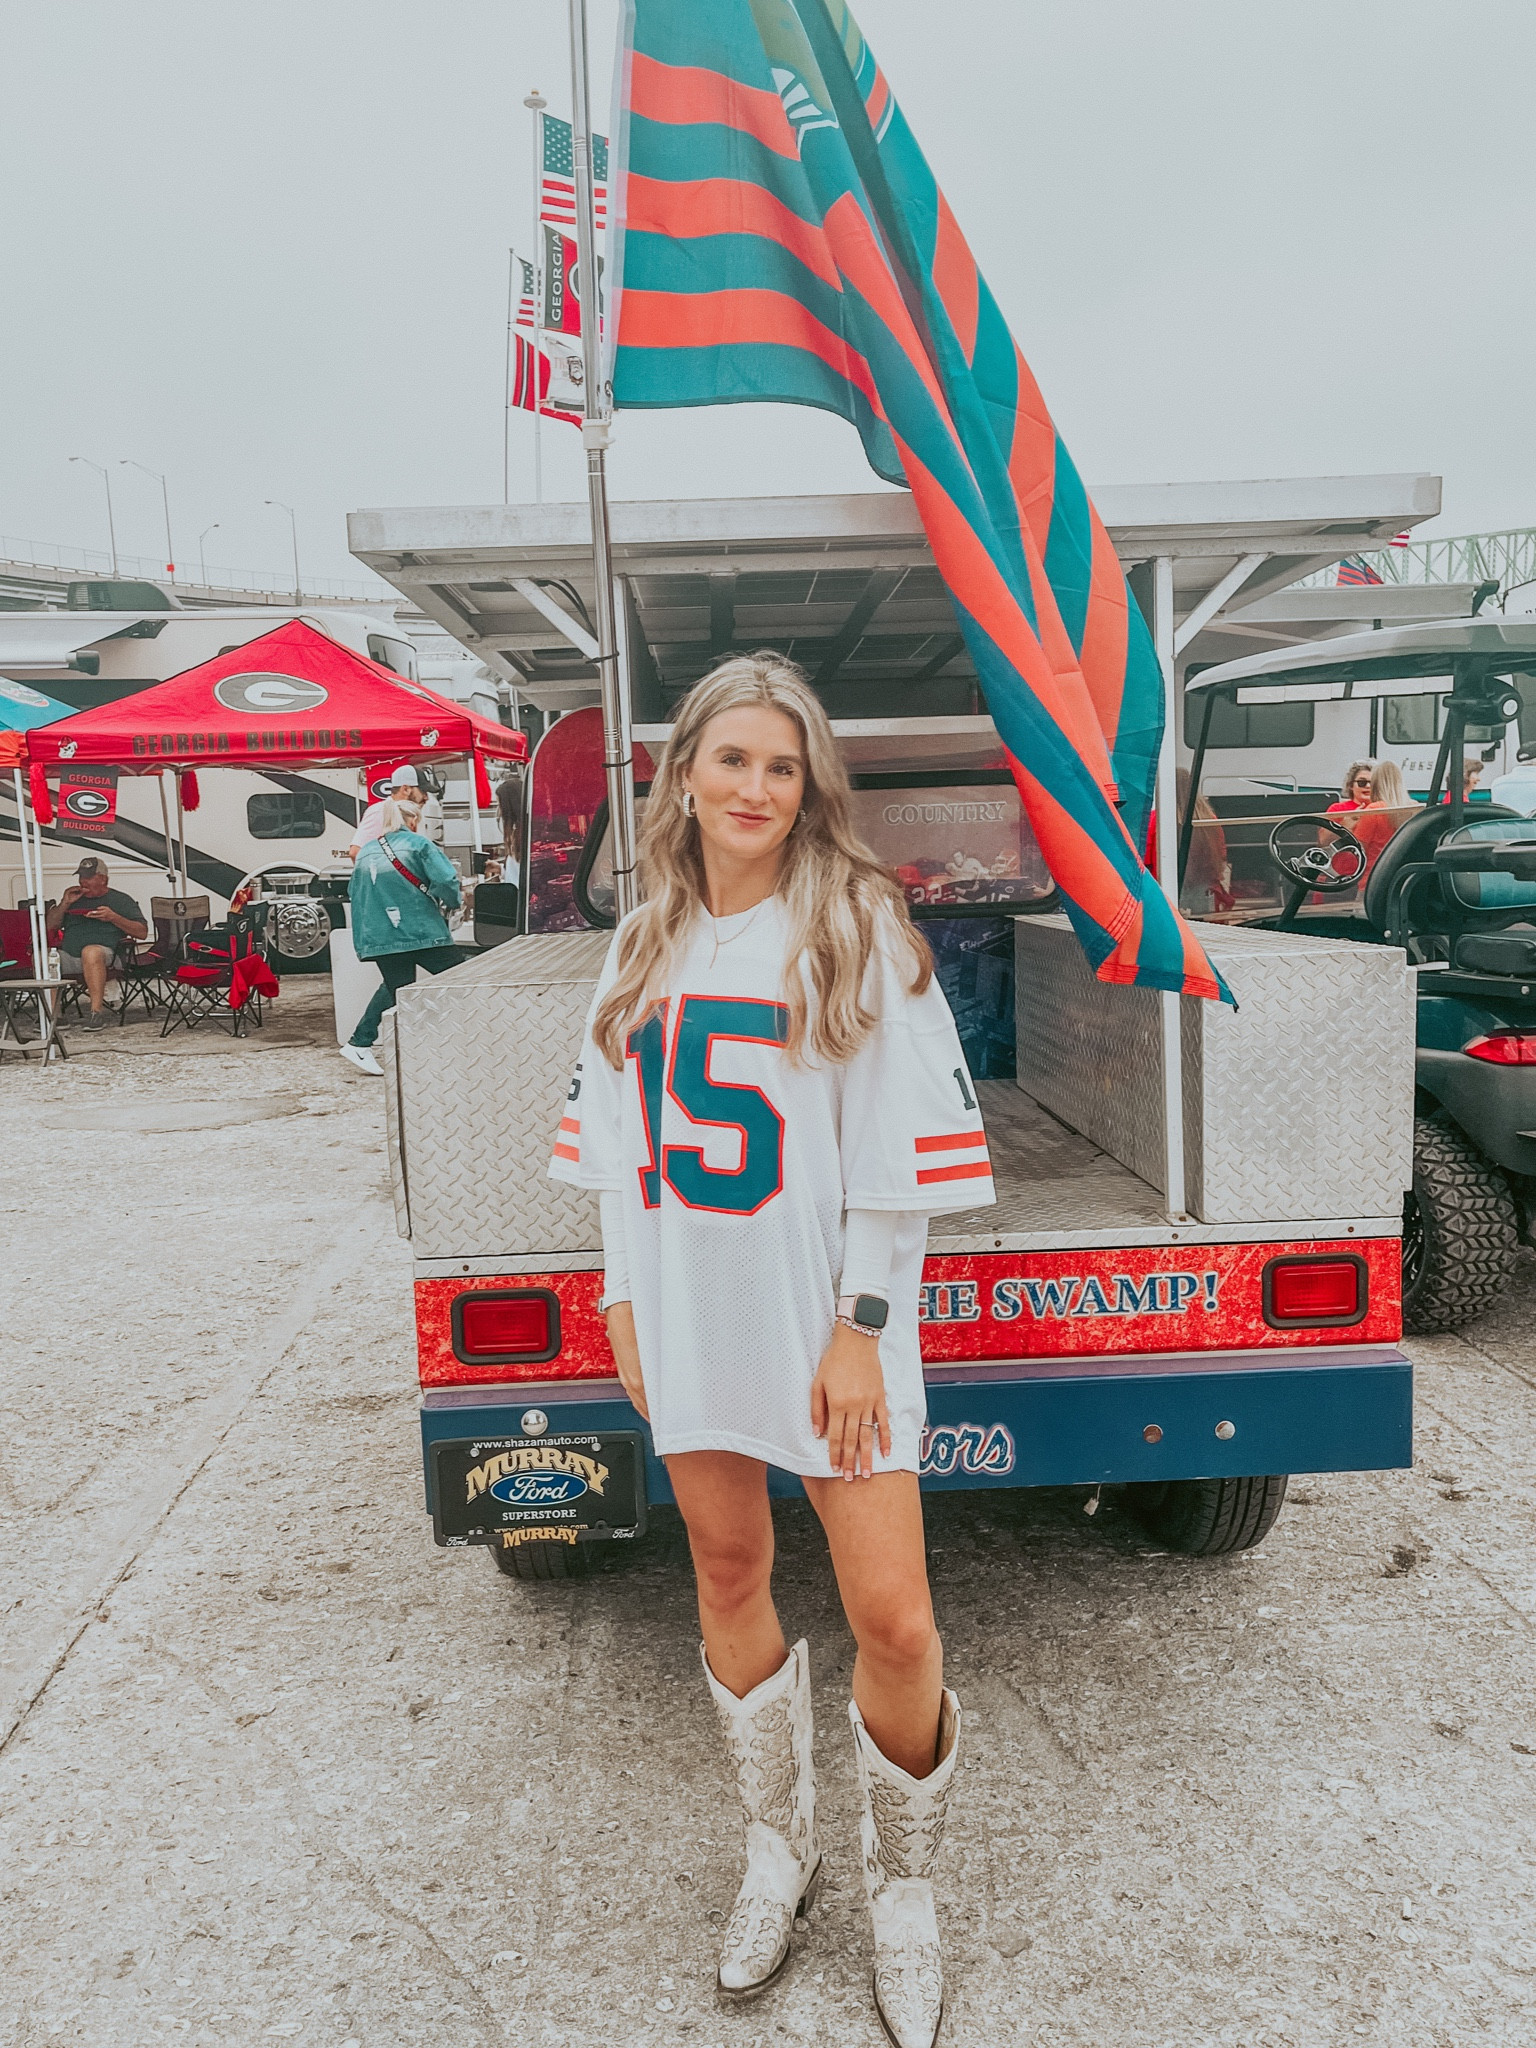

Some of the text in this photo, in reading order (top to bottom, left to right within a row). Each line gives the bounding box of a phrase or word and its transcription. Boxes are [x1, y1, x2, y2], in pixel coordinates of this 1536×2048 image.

[551, 233, 563, 322] GEORGIA
[132, 729, 363, 756] GEORGIA BULLDOGS
[68, 774, 111, 785] GEORGIA
[883, 801, 1007, 826] COUNTRY
[63, 821, 106, 832] BULLDOGS
[953, 1067, 976, 1111] 1
[625, 993, 790, 1216] 15
[991, 1271, 1219, 1321] SWAMP!
[473, 1436, 598, 1449] www.shazamauto.com
[465, 1447, 610, 1504] MURRAY
[508, 1476, 570, 1500] Ford
[502, 1509, 577, 1521] SUPERSTORE
[446, 1536, 469, 1546] Ford
[503, 1526, 579, 1548] MURRAY
[612, 1529, 635, 1538] Ford
